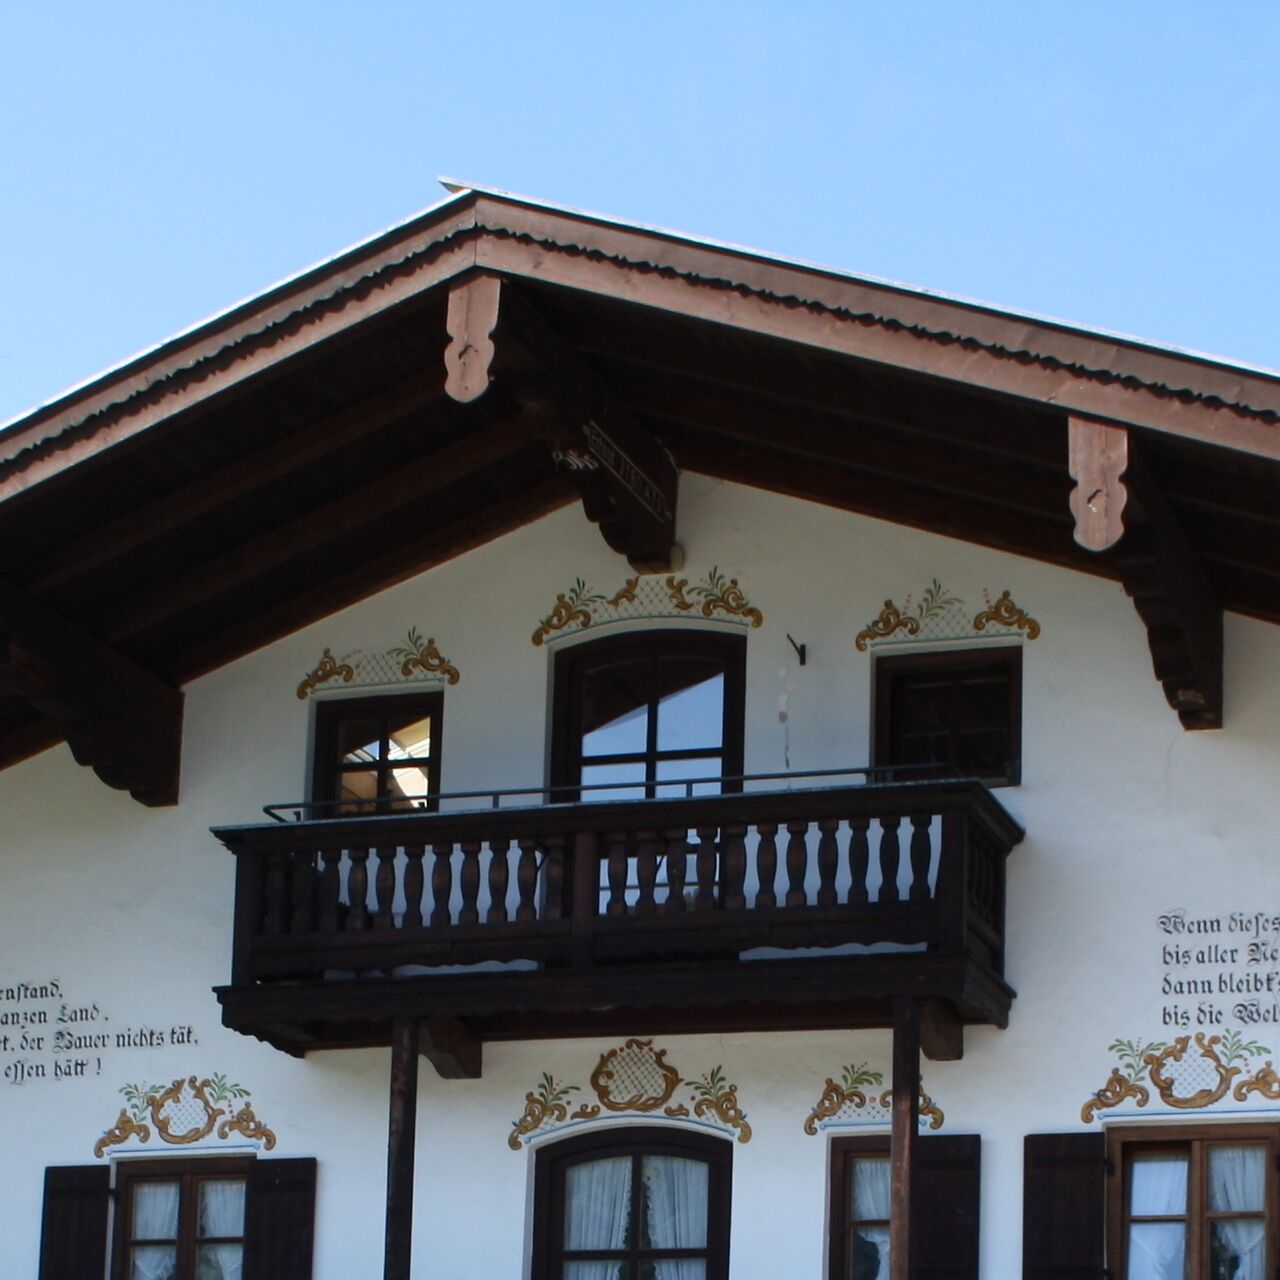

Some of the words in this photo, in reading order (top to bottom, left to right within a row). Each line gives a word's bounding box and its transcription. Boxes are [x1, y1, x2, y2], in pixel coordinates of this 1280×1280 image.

[1157, 910, 1221, 934] Wenn
[1163, 944, 1191, 967] bis
[1196, 944, 1239, 964] aller
[1162, 973, 1213, 995] dann
[1163, 1005, 1190, 1029] bis
[1197, 1001, 1223, 1025] die
[20, 1031, 44, 1050] der
[53, 1027, 110, 1054] Bauer
[116, 1026, 164, 1048] nichts
